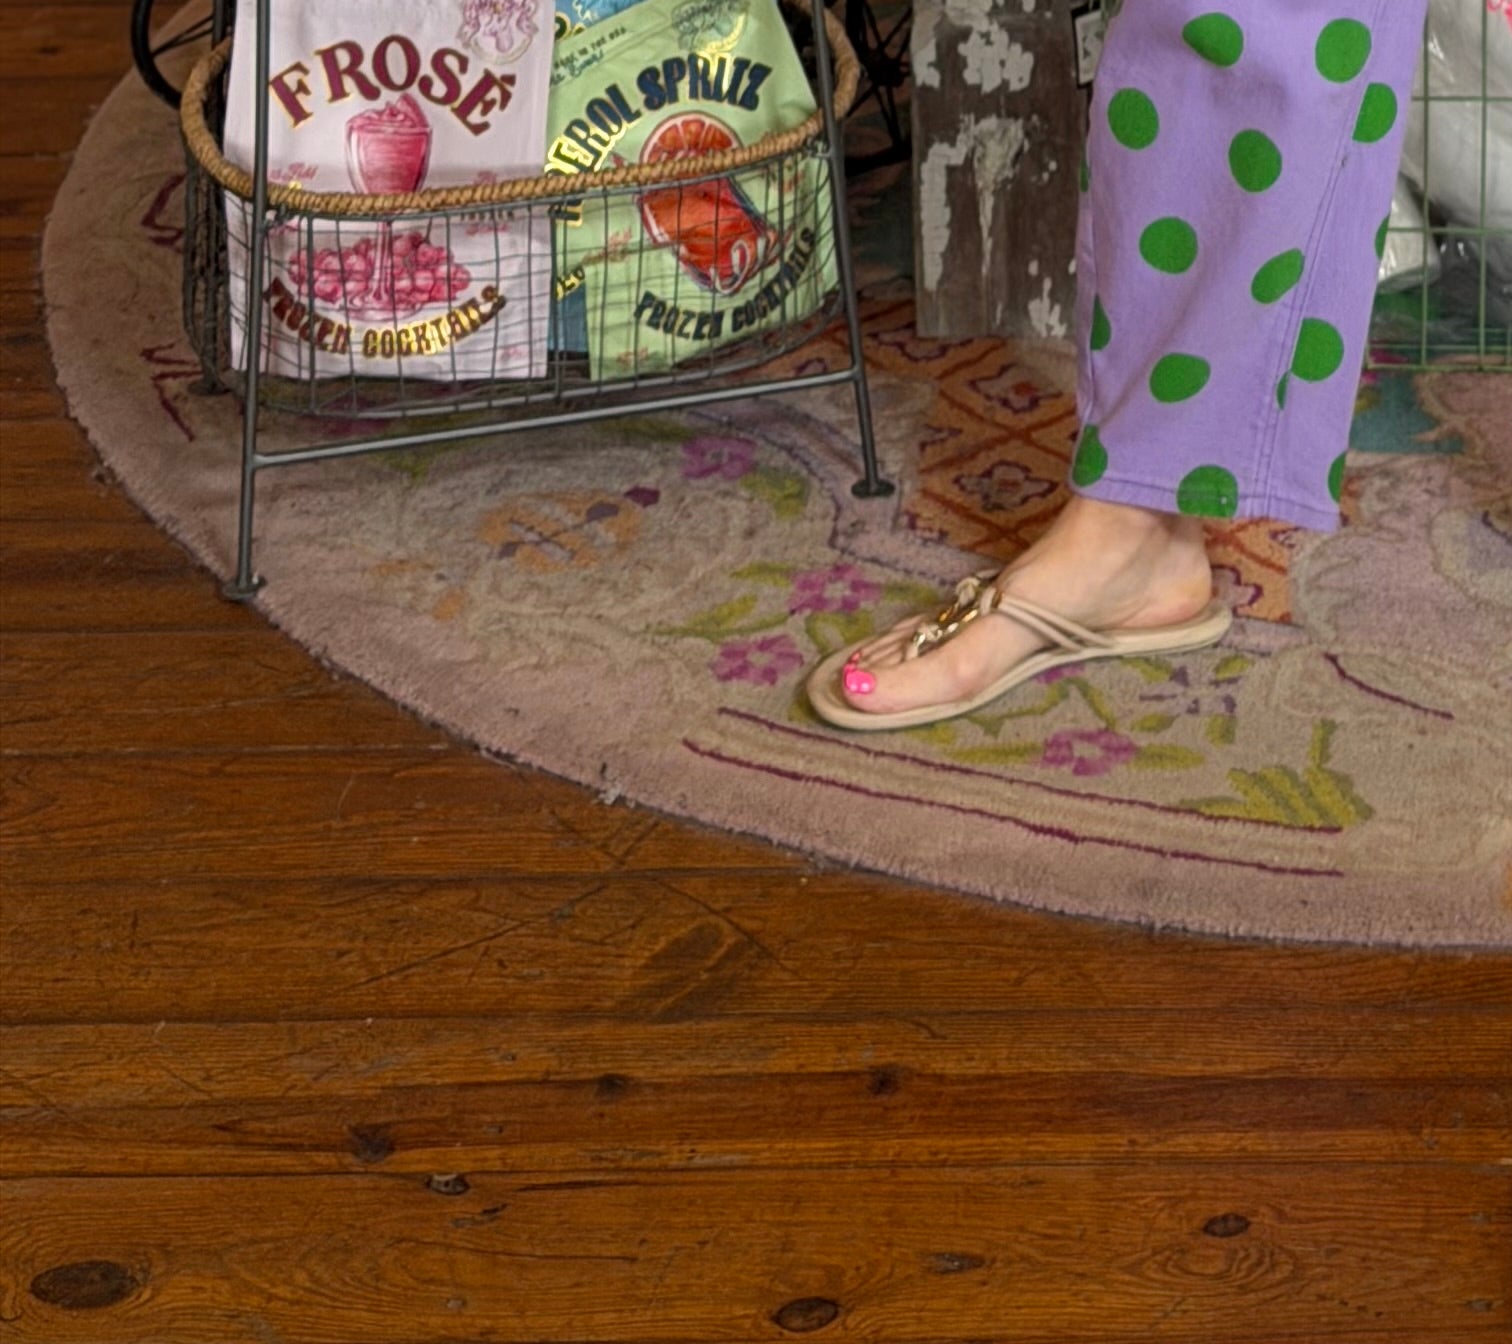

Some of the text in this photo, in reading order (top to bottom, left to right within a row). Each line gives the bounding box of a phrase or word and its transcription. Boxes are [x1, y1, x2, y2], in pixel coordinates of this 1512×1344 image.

[268, 34, 517, 137] FROSÉ
[636, 52, 773, 112] SPRITZ
[263, 276, 508, 359] FROZEN COCKTAILS
[633, 289, 725, 342] FROZEN
